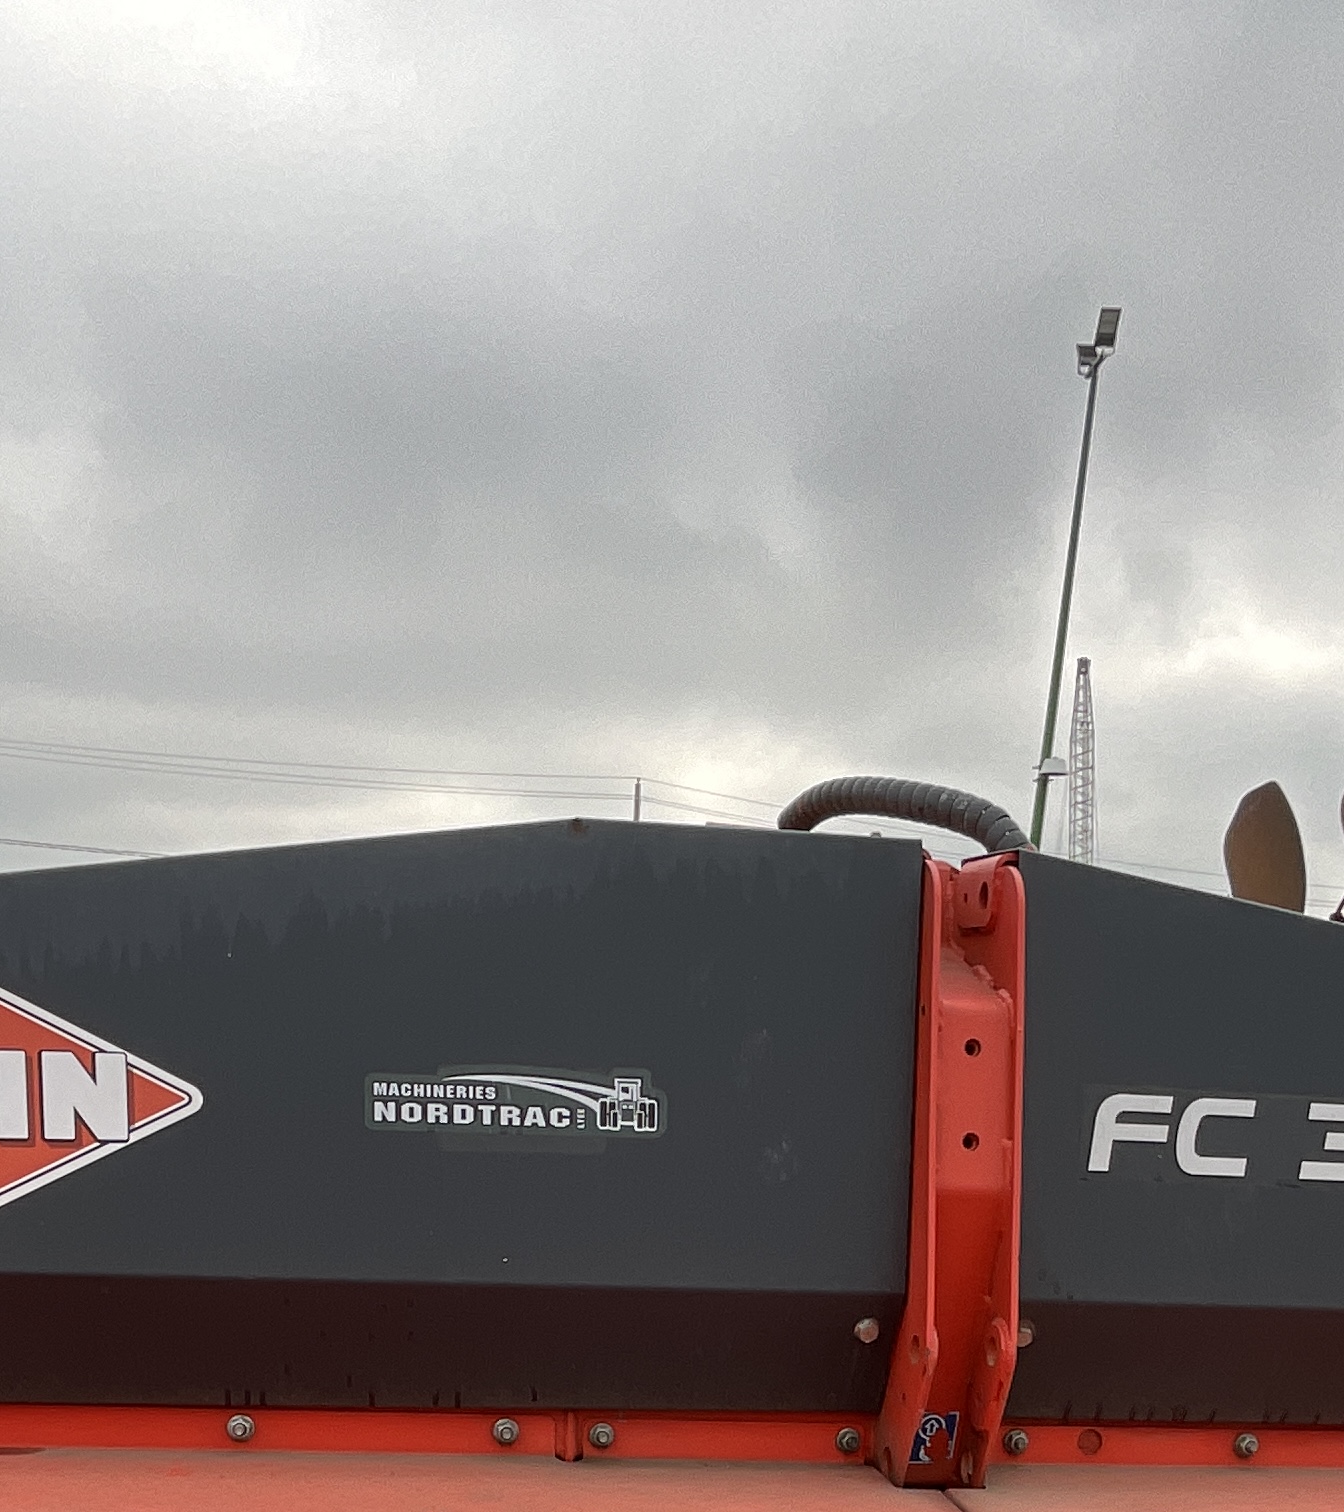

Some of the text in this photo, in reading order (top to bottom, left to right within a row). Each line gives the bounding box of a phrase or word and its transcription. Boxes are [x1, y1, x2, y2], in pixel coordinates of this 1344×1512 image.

[372, 1082, 497, 1100] MACHINERIES
[373, 1101, 571, 1128] NORDTRAC
[1087, 1093, 1257, 1178] FC
